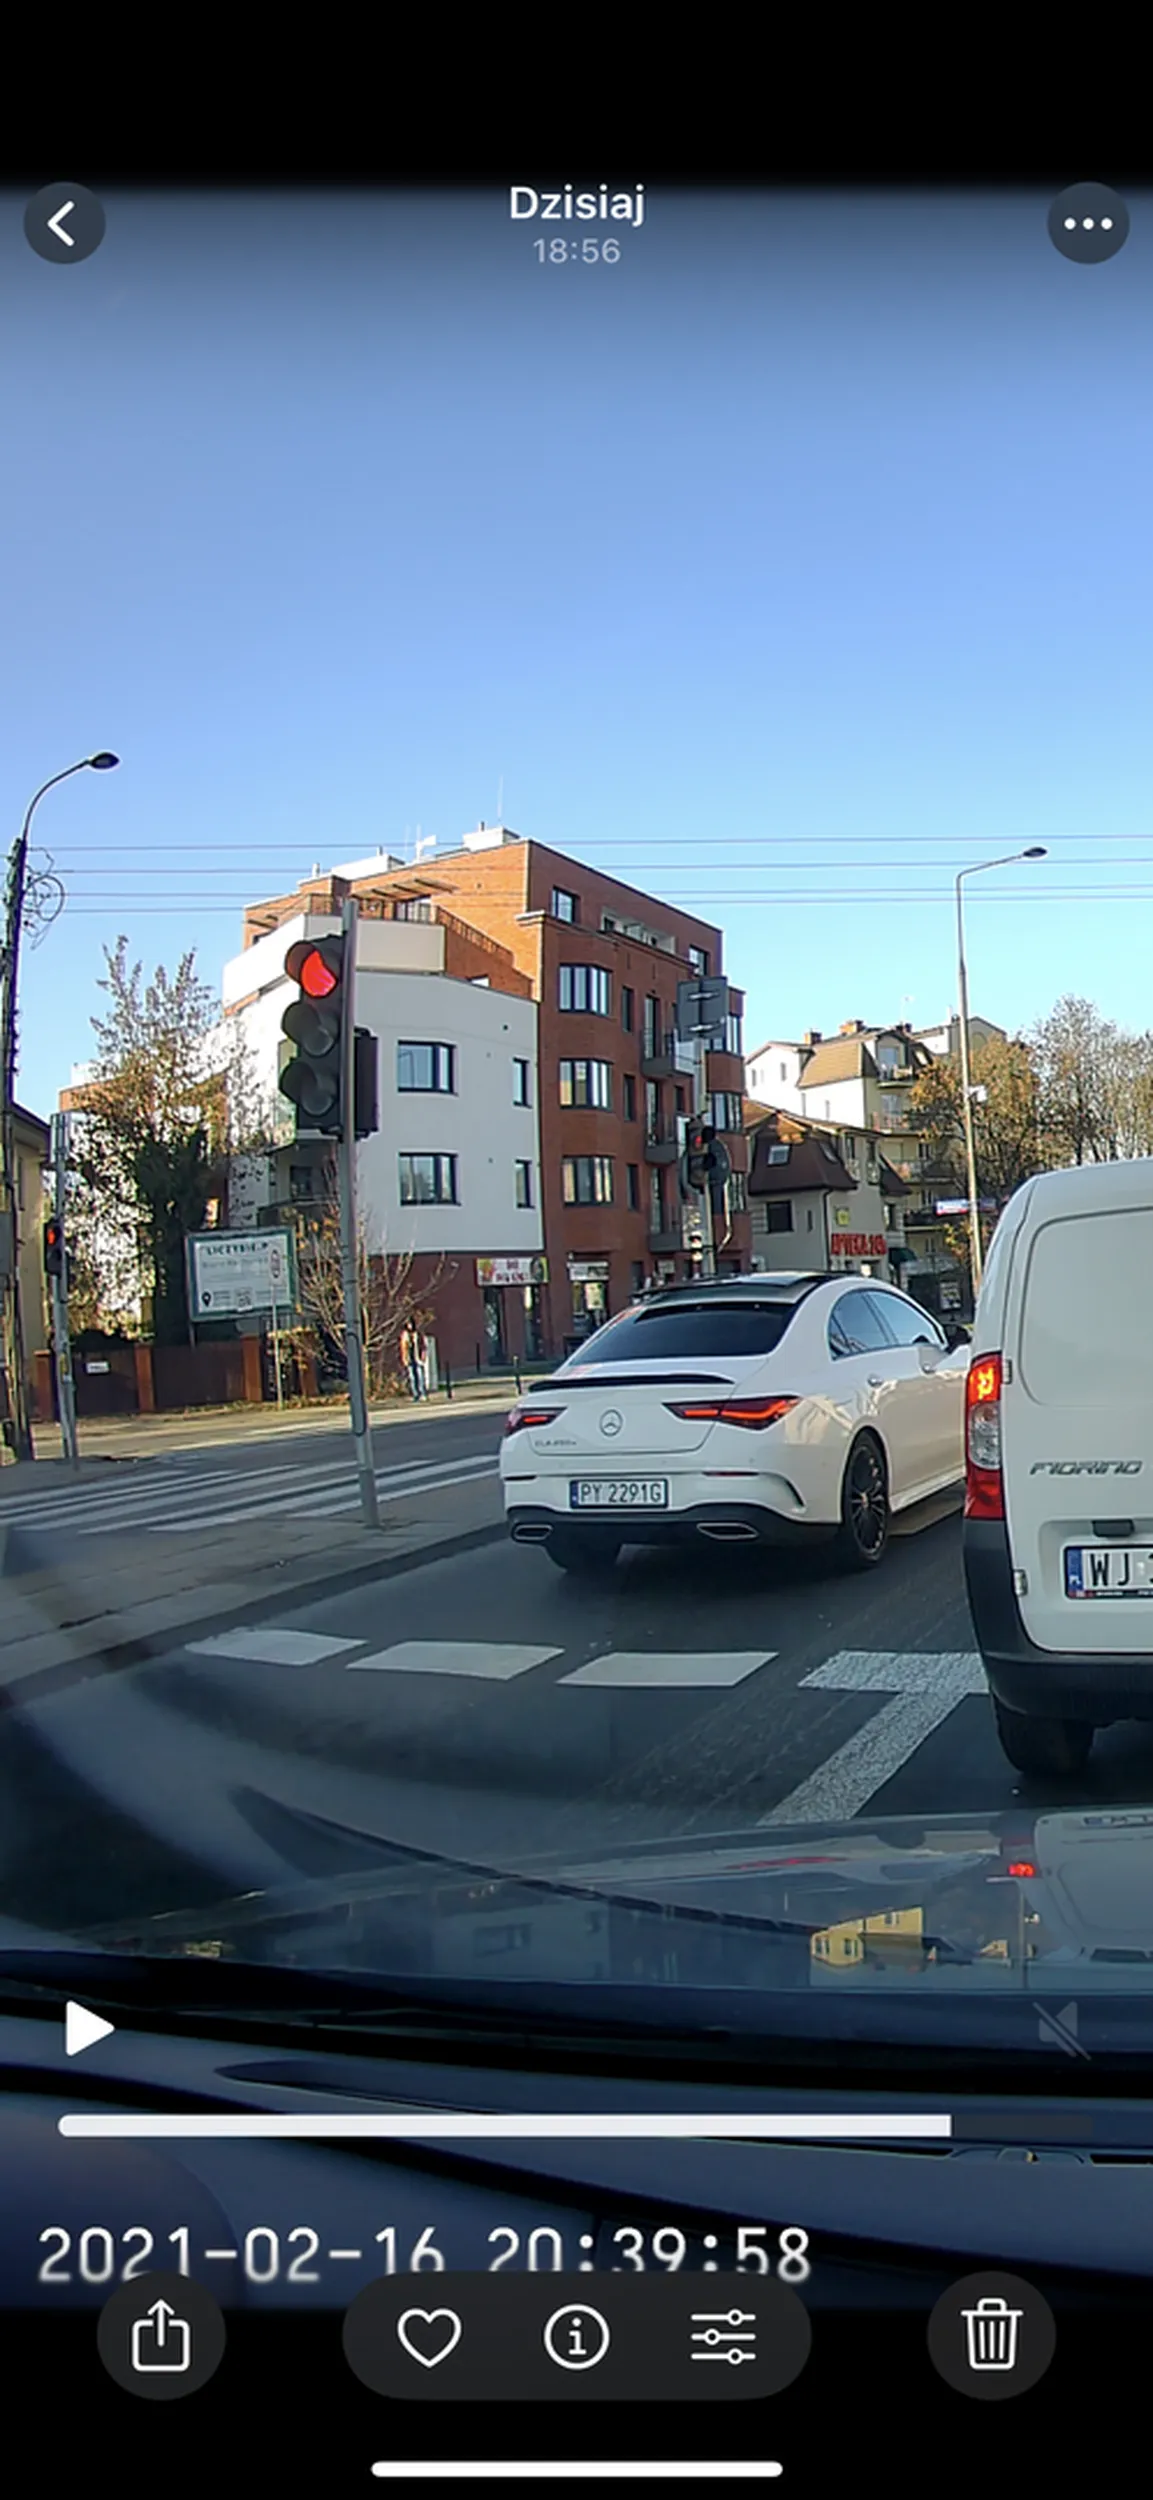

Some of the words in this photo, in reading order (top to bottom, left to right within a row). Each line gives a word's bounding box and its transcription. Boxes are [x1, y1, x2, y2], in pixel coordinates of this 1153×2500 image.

[1029, 1460, 1143, 1476] FIORINO
[580, 1483, 601, 1503] PY
[608, 1483, 662, 1503] 2291G
[1090, 1552, 1130, 1586] WJ
